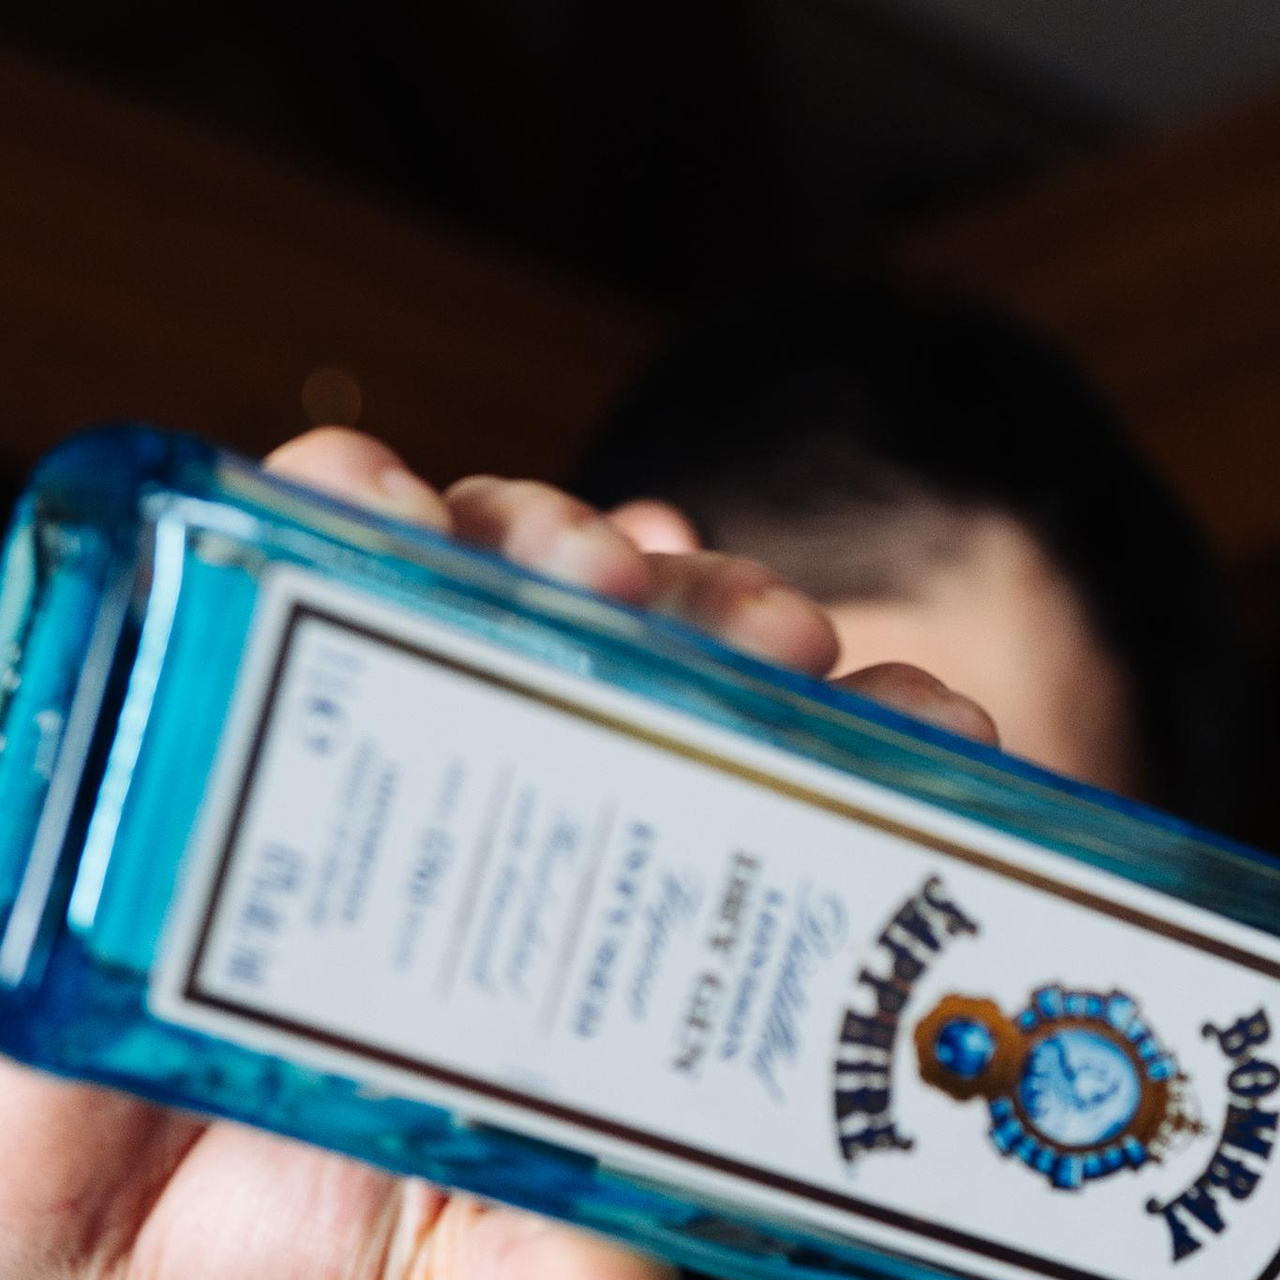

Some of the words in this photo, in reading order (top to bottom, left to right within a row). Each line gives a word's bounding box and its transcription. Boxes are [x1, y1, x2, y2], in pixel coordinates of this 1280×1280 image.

[706, 851, 760, 957] DRY
[672, 967, 726, 1075] GIN
[832, 870, 981, 1164] SAPPHIRE
